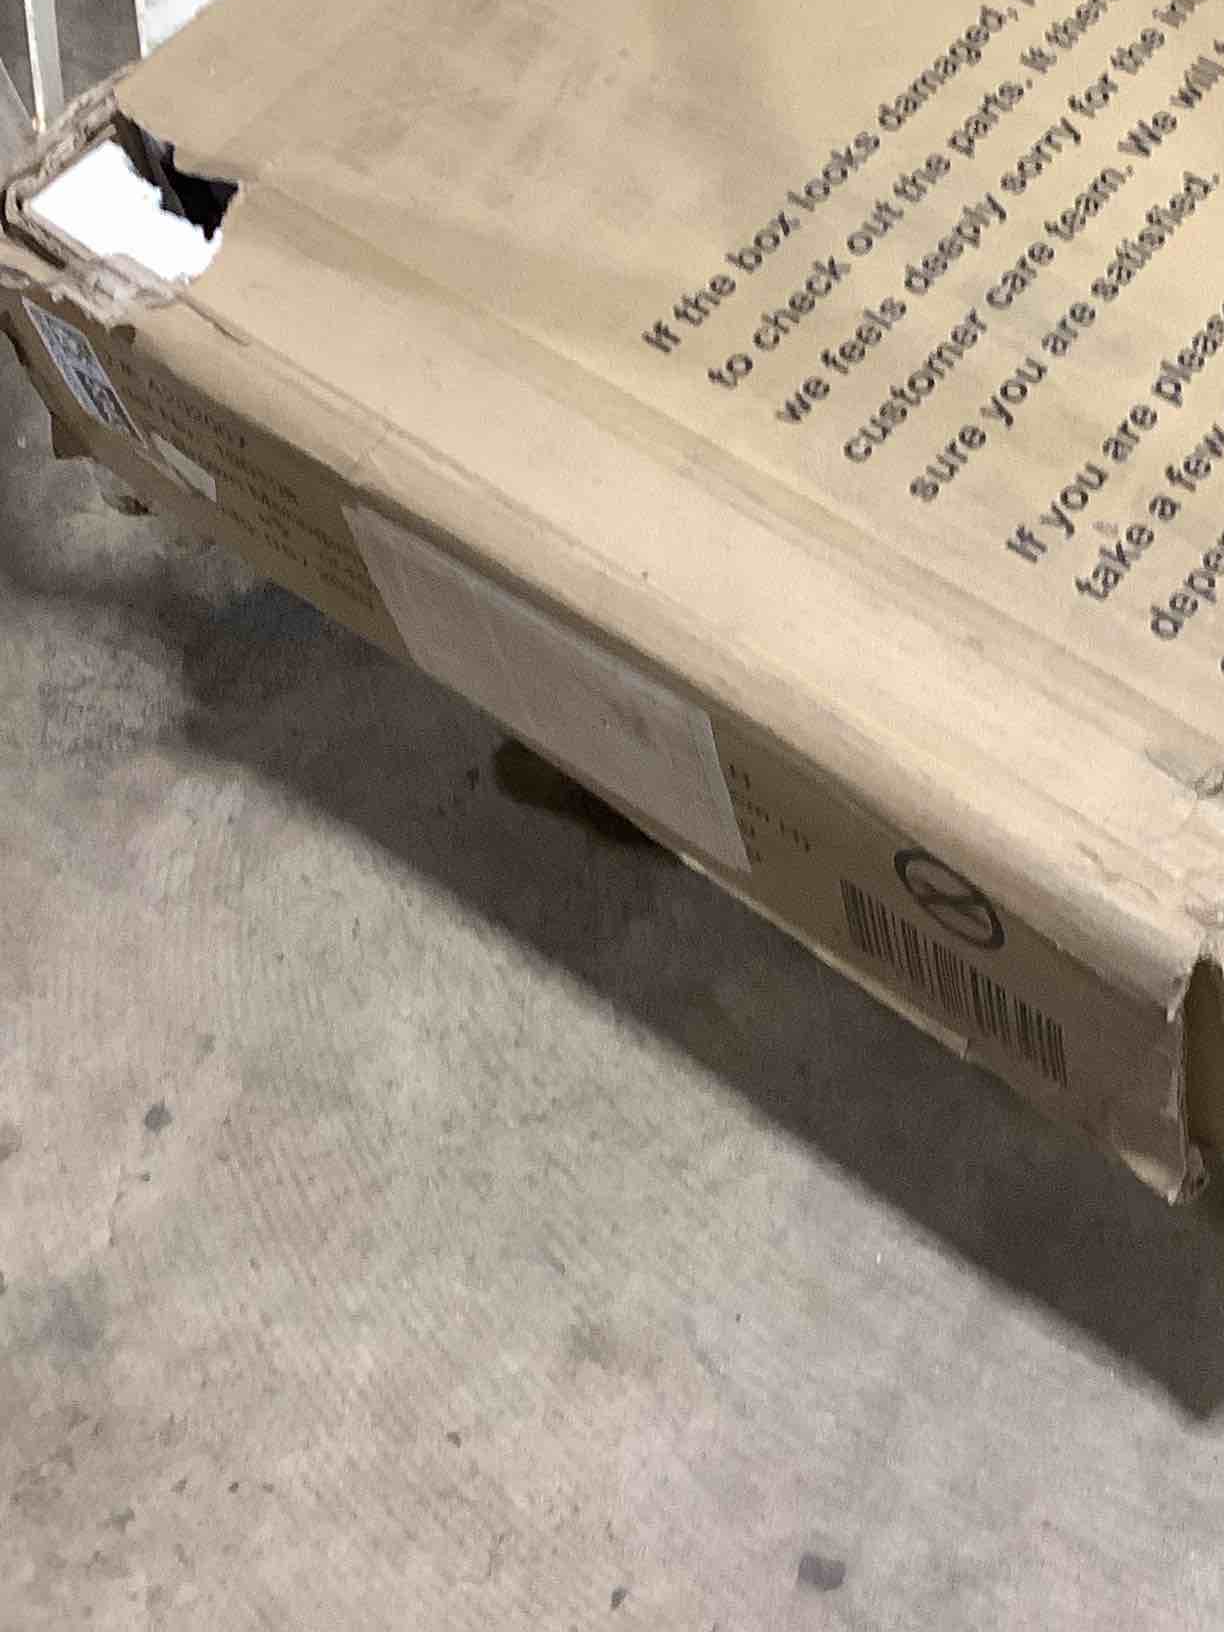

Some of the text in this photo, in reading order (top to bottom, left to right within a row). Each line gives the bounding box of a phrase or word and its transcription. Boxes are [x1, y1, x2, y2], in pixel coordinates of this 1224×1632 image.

[641, 320, 682, 355] If
[673, 275, 737, 327] the
[726, 211, 800, 274] box
[787, 131, 881, 213] looks
[877, 4, 1019, 132] damaged,
[707, 353, 754, 390] to
[753, 255, 851, 351] check
[846, 200, 905, 256] out
[893, 154, 952, 203] the
[775, 377, 831, 424] we
[820, 297, 908, 376] feels
[903, 192, 1008, 296] deeply
[1000, 116, 1082, 195] sorry
[1067, 72, 1119, 119] for
[1109, 28, 1166, 75] the
[843, 307, 988, 464] customer
[985, 242, 1055, 311] care
[1043, 165, 1133, 242] team.
[1117, 111, 1178, 159] We
[909, 425, 987, 503] sure
[979, 356, 1048, 431] you
[1041, 302, 1097, 357] are
[1005, 523, 1048, 565] If
[1039, 461, 1110, 540] you
[1101, 405, 1158, 464] are
[1074, 522, 1155, 602] take
[1148, 494, 1182, 523] a
